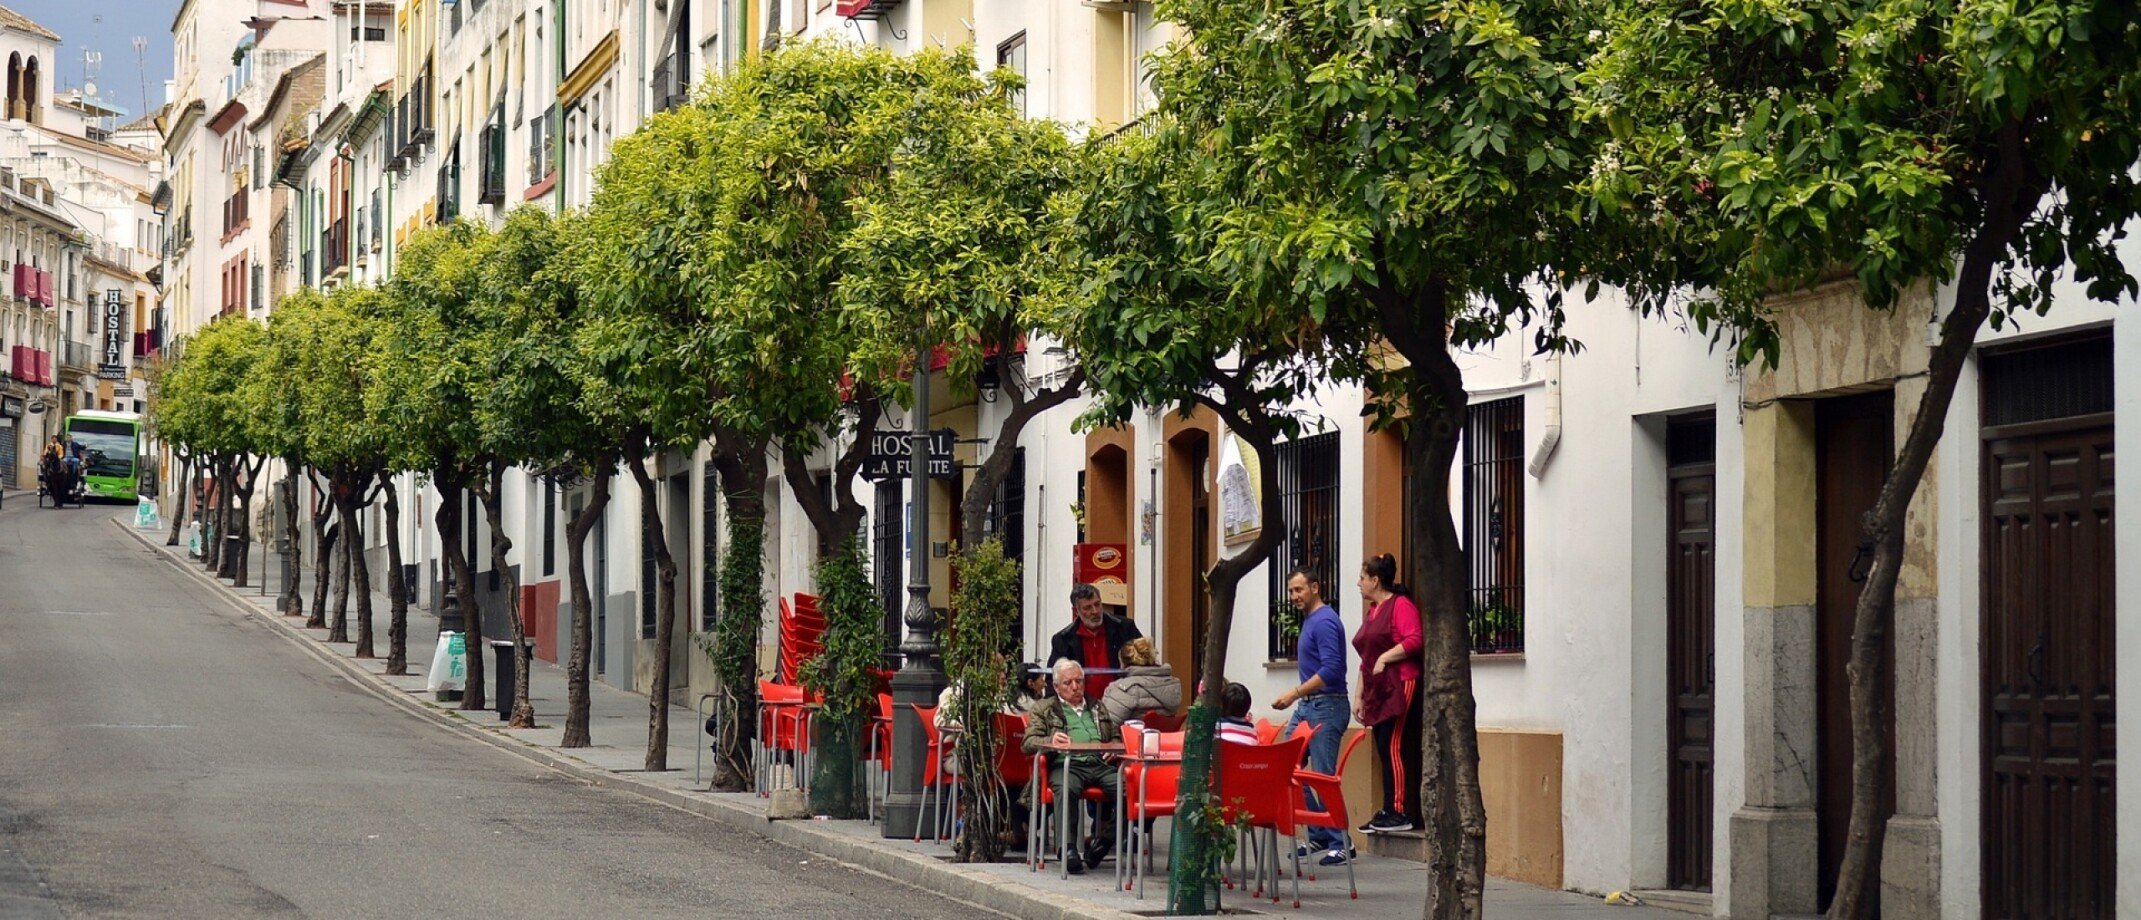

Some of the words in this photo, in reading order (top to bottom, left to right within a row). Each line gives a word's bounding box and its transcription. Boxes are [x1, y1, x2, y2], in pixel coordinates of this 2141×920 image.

[107, 291, 119, 366] HOSTAL
[871, 435, 949, 455] HOSAL
[872, 461, 889, 474] LA
[896, 461, 950, 474] FUTE
